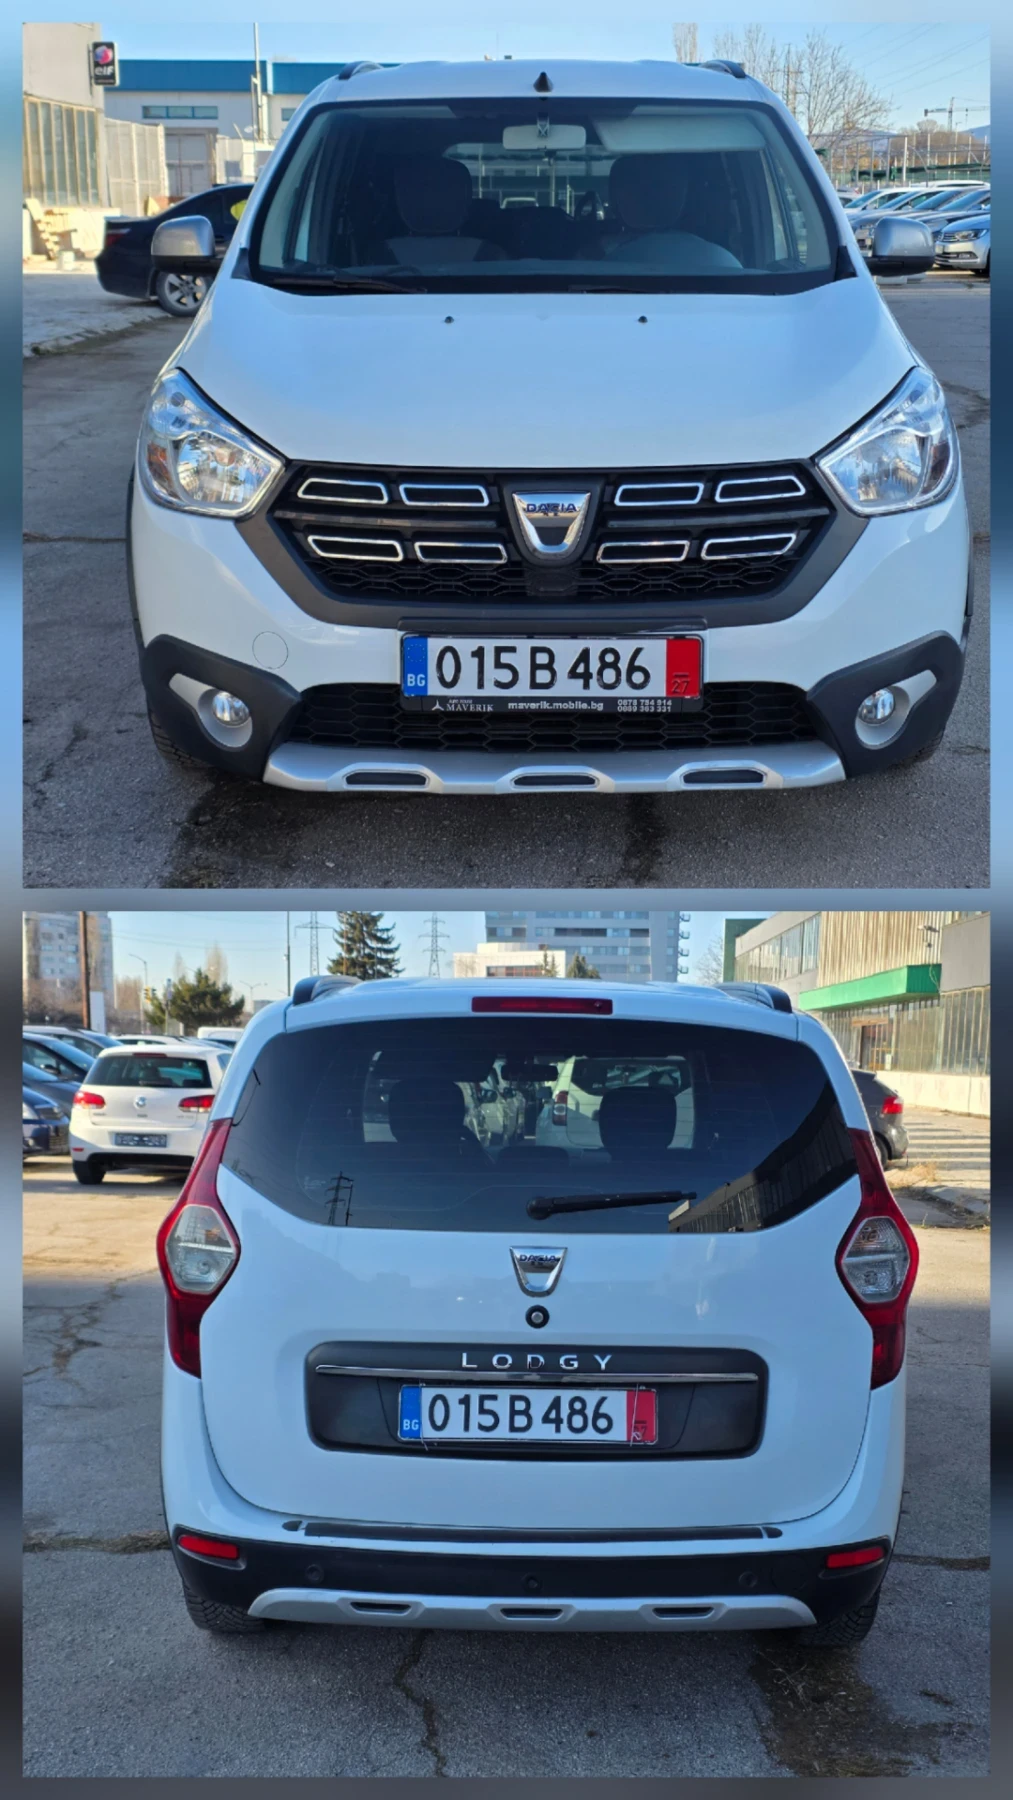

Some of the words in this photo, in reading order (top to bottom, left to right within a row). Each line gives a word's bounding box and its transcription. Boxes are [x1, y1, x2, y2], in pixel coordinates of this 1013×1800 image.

[94, 65, 114, 76] elf
[526, 503, 578, 513] DACIA
[407, 674, 426, 687] BG
[672, 679, 690, 694] 27
[446, 703, 494, 712] MAVERIK
[508, 701, 604, 711] maverik.mobile.bg
[519, 1254, 557, 1262] DACIA
[461, 1353, 612, 1371] LODGY
[402, 1419, 419, 1431] BG
